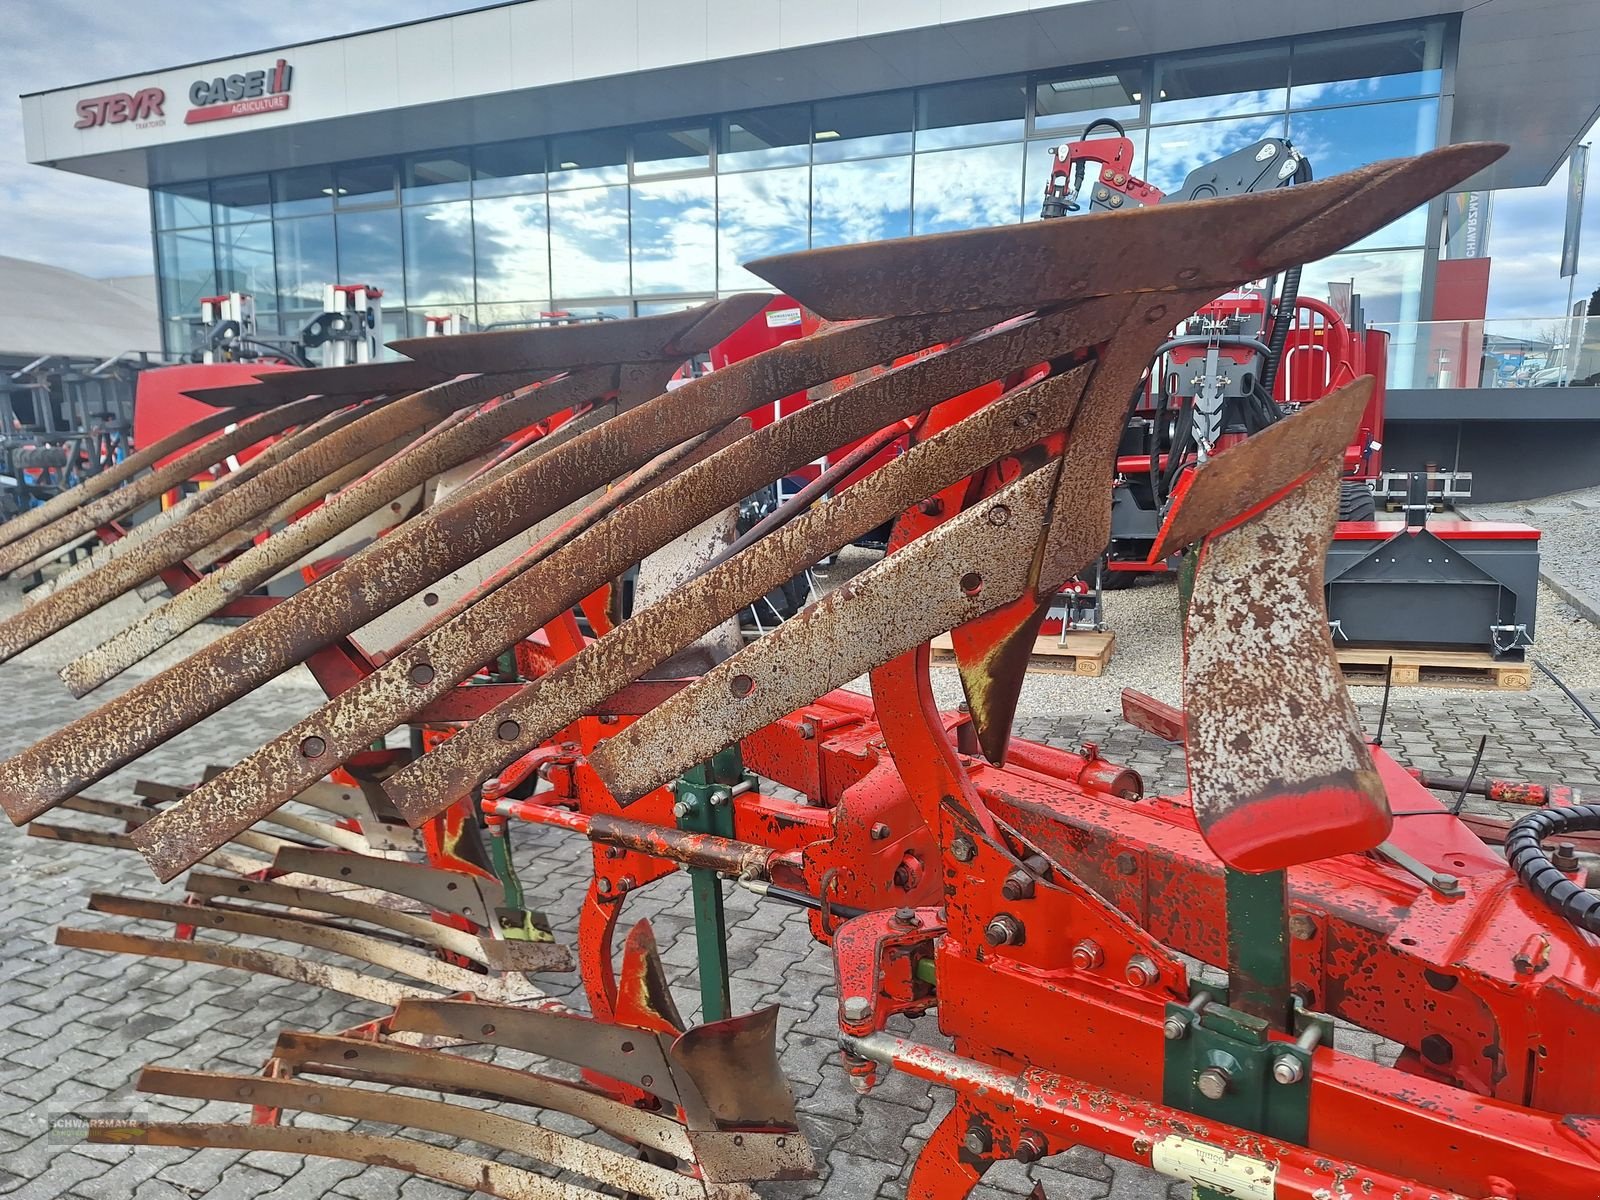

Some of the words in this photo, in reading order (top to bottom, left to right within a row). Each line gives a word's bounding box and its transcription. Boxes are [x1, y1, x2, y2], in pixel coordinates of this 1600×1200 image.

[189, 70, 265, 106] CASE
[231, 97, 284, 114] AGRICULTURE
[74, 87, 166, 130] STEYR
